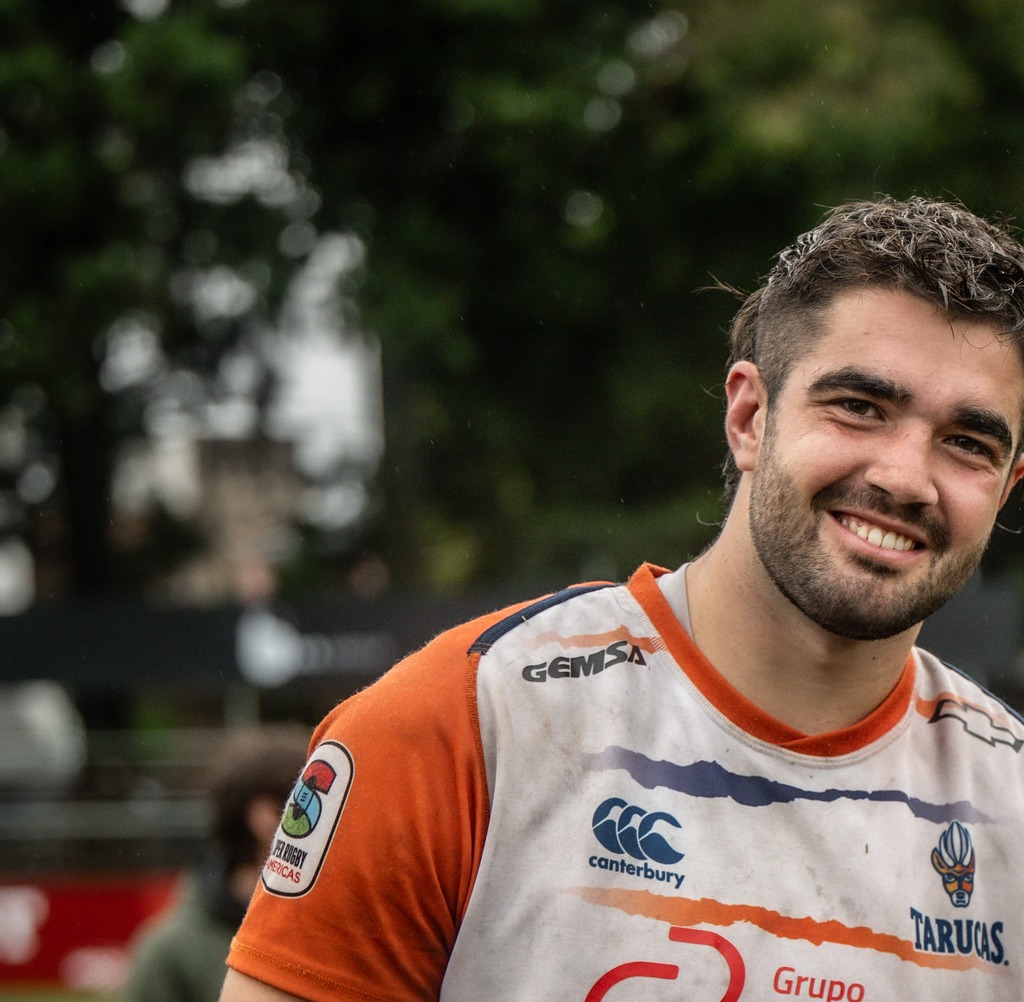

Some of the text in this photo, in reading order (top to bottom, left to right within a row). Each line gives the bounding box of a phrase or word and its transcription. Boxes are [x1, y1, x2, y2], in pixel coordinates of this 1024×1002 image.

[522, 640, 647, 683] GEMSA
[281, 842, 308, 870] RUGBY
[588, 853, 685, 889] canterbury
